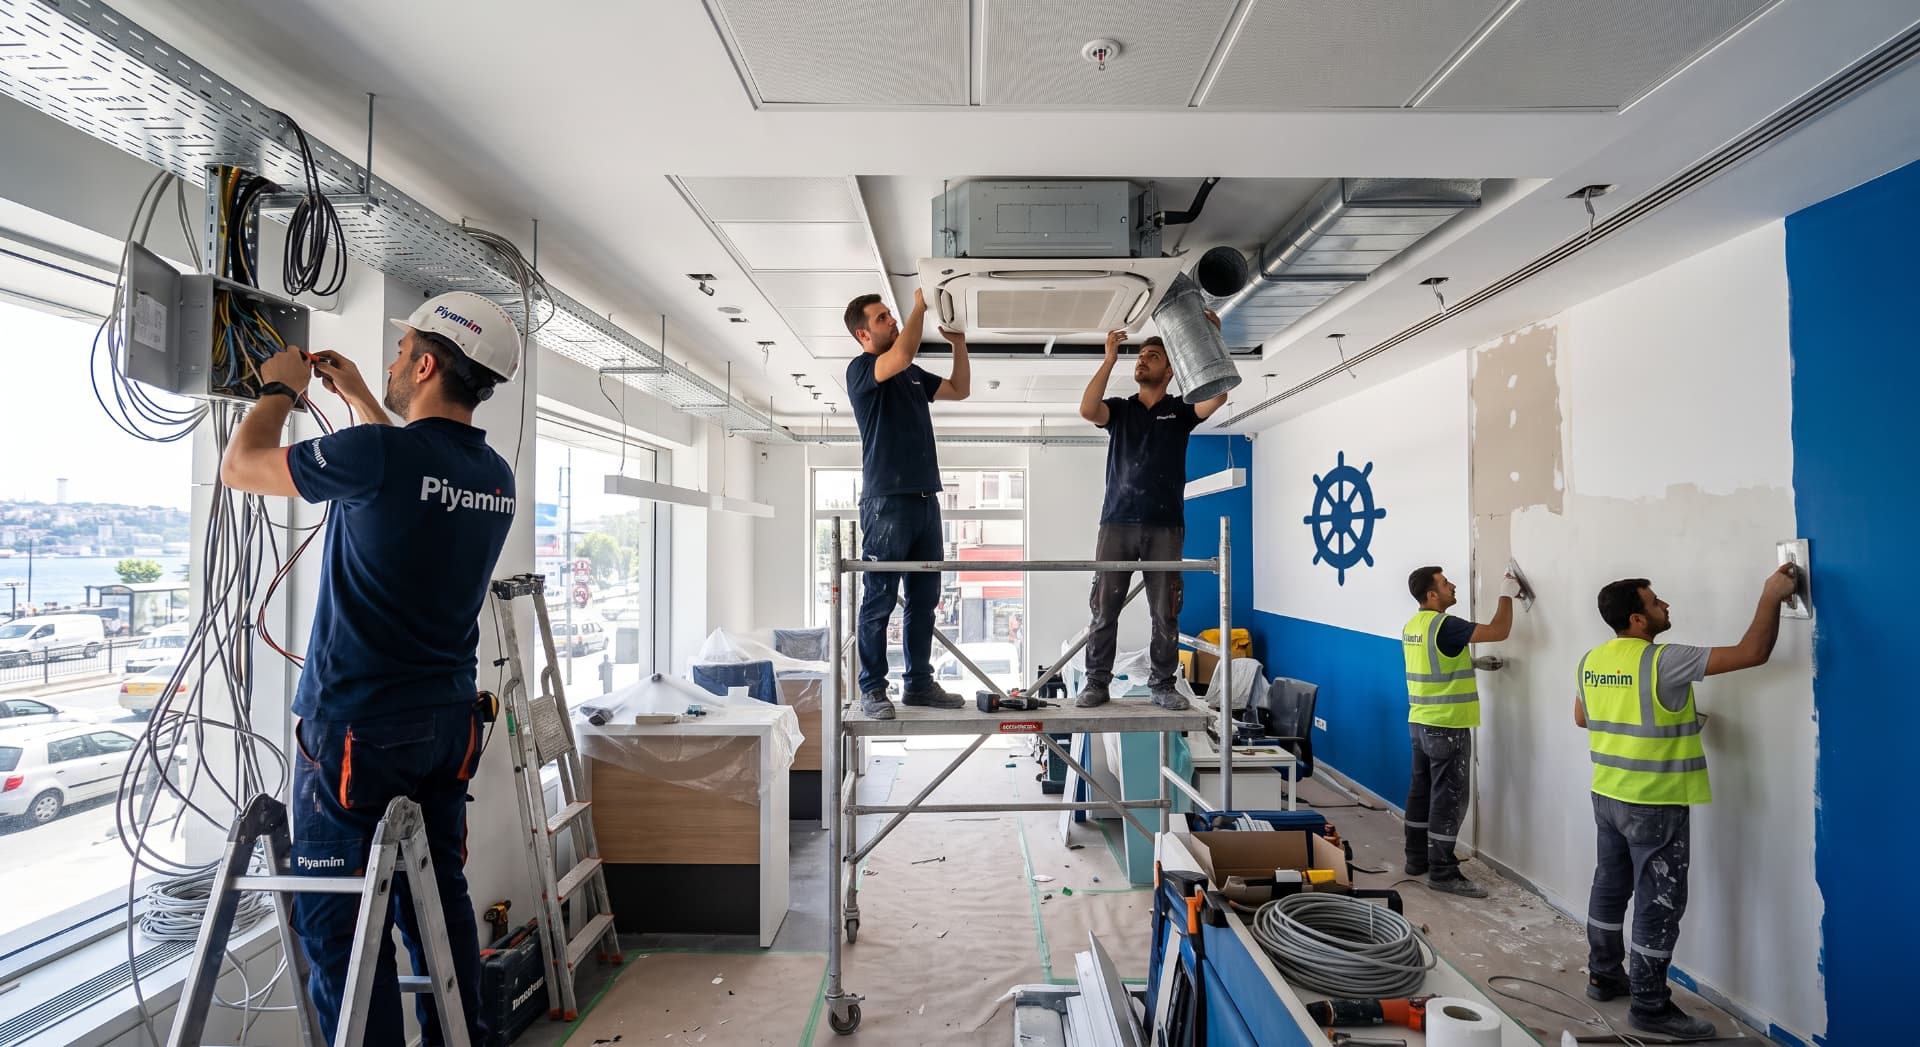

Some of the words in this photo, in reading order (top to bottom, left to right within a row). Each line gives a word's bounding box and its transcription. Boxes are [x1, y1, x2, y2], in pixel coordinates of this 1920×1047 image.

[434, 305, 482, 335] Piyamim
[420, 475, 515, 515] Piyamim
[1584, 669, 1633, 688] Piyamim
[297, 856, 345, 870] Piyamim
